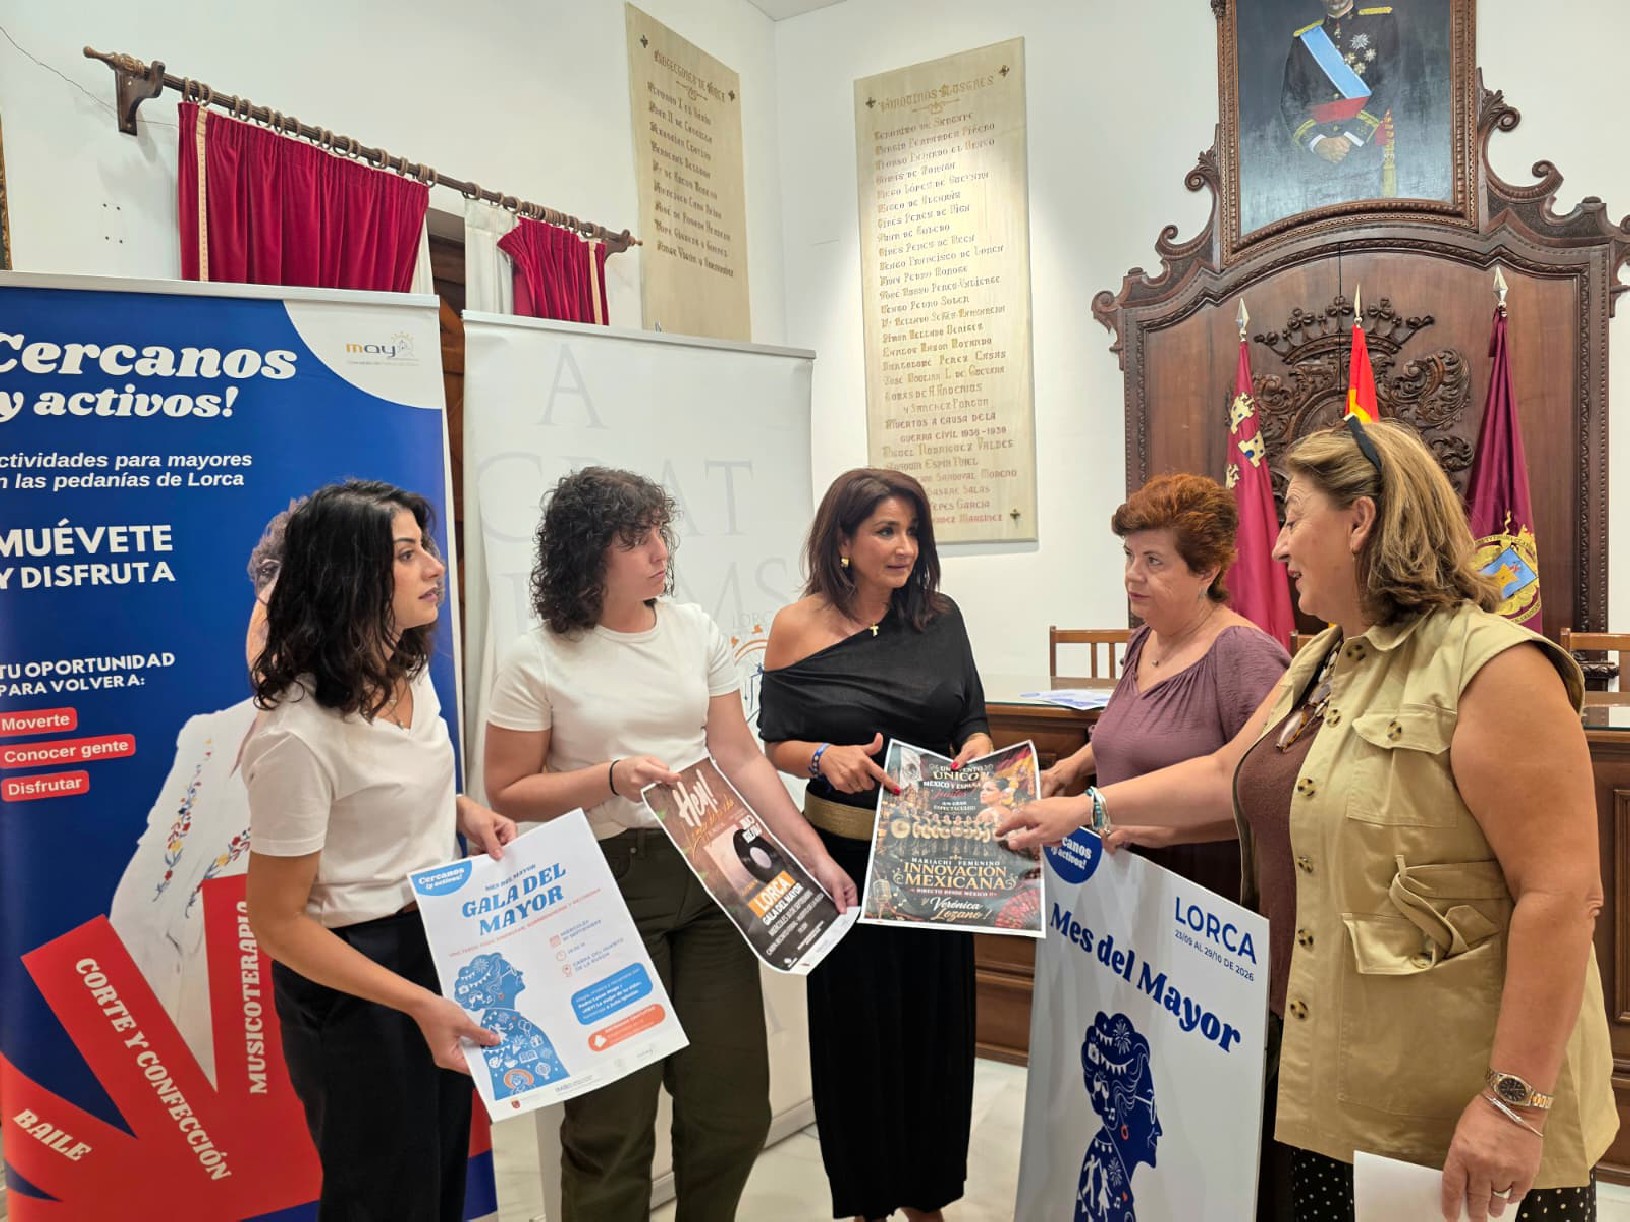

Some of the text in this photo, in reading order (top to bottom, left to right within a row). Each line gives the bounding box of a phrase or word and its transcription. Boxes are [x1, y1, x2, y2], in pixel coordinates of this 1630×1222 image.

[33, 384, 239, 417] activos!
[0, 453, 252, 470] ctividades para mayores
[15, 473, 46, 489] las
[53, 471, 150, 491] pedanías
[156, 471, 182, 487] de
[188, 472, 244, 486] Lorca
[0, 518, 173, 557] MUÉVETE
[21, 561, 176, 588] DISFRUTA
[25, 652, 175, 677] OPORTUNIDAD
[51, 675, 124, 693] VOLVER
[2, 714, 70, 731] Moverte
[4, 740, 129, 763] Conocer gente
[8, 777, 82, 795] Disfrutar
[912, 857, 952, 866] MARIACHI
[1062, 837, 1092, 859] canos
[462, 863, 566, 918] GALA DEL
[753, 877, 790, 913] LORCA
[905, 874, 1006, 890] MEXICANA
[480, 885, 564, 936] MAYOR
[1176, 896, 1257, 965] LORCA
[1194, 941, 1203, 953] AL
[1204, 947, 1222, 963] 29/10
[1224, 958, 1234, 971] DE
[1050, 902, 1242, 1053] Mes del Mayor
[75, 958, 232, 1181] CORTE Y CONFECCIÓN
[12, 1108, 92, 1161] BAILE
